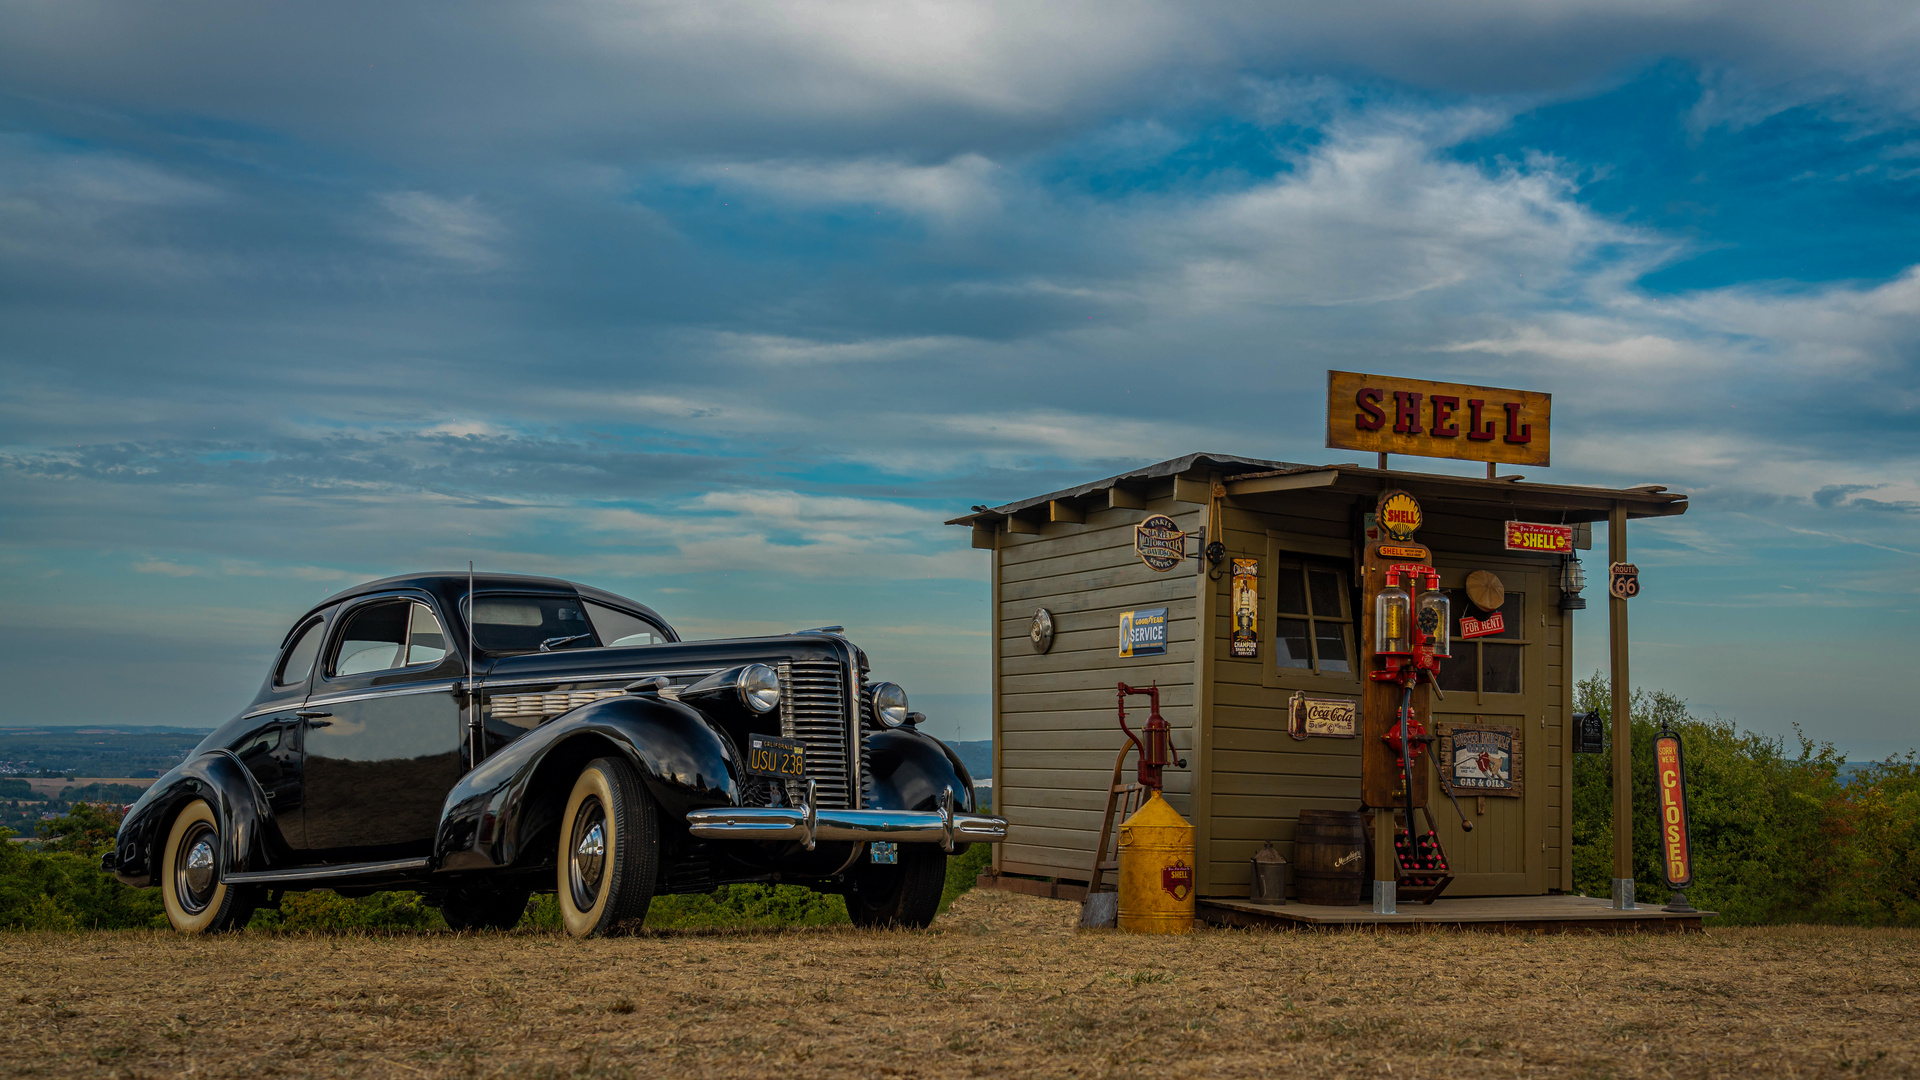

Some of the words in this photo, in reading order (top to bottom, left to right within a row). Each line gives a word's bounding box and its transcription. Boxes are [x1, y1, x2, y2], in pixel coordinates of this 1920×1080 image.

[1355, 387, 1532, 444] SHELL
[1388, 509, 1416, 524] SHELL
[1150, 518, 1173, 529] PARTS
[1138, 532, 1183, 554] MOTORCYCLES
[1523, 532, 1557, 549] SHELL
[1382, 547, 1404, 556] SHELL
[1150, 557, 1173, 568] SERVICE
[1615, 566, 1636, 574] ROUTE
[1616, 577, 1636, 595] 66
[1135, 616, 1164, 626] GOODYEAR
[1464, 621, 1480, 634] FOR
[1481, 617, 1500, 630] RENT
[1130, 626, 1164, 642] SERVICE
[764, 741, 793, 750] CALIFORNIA
[1659, 747, 1676, 755] SORRY
[752, 749, 777, 771] USU
[782, 754, 803, 775] 238
[1460, 778, 1476, 787] GAS
[1478, 779, 1484, 787] &
[1486, 780, 1505, 788] OILS
[1662, 770, 1684, 878] CLOSED
[1171, 870, 1188, 879] SHELL
